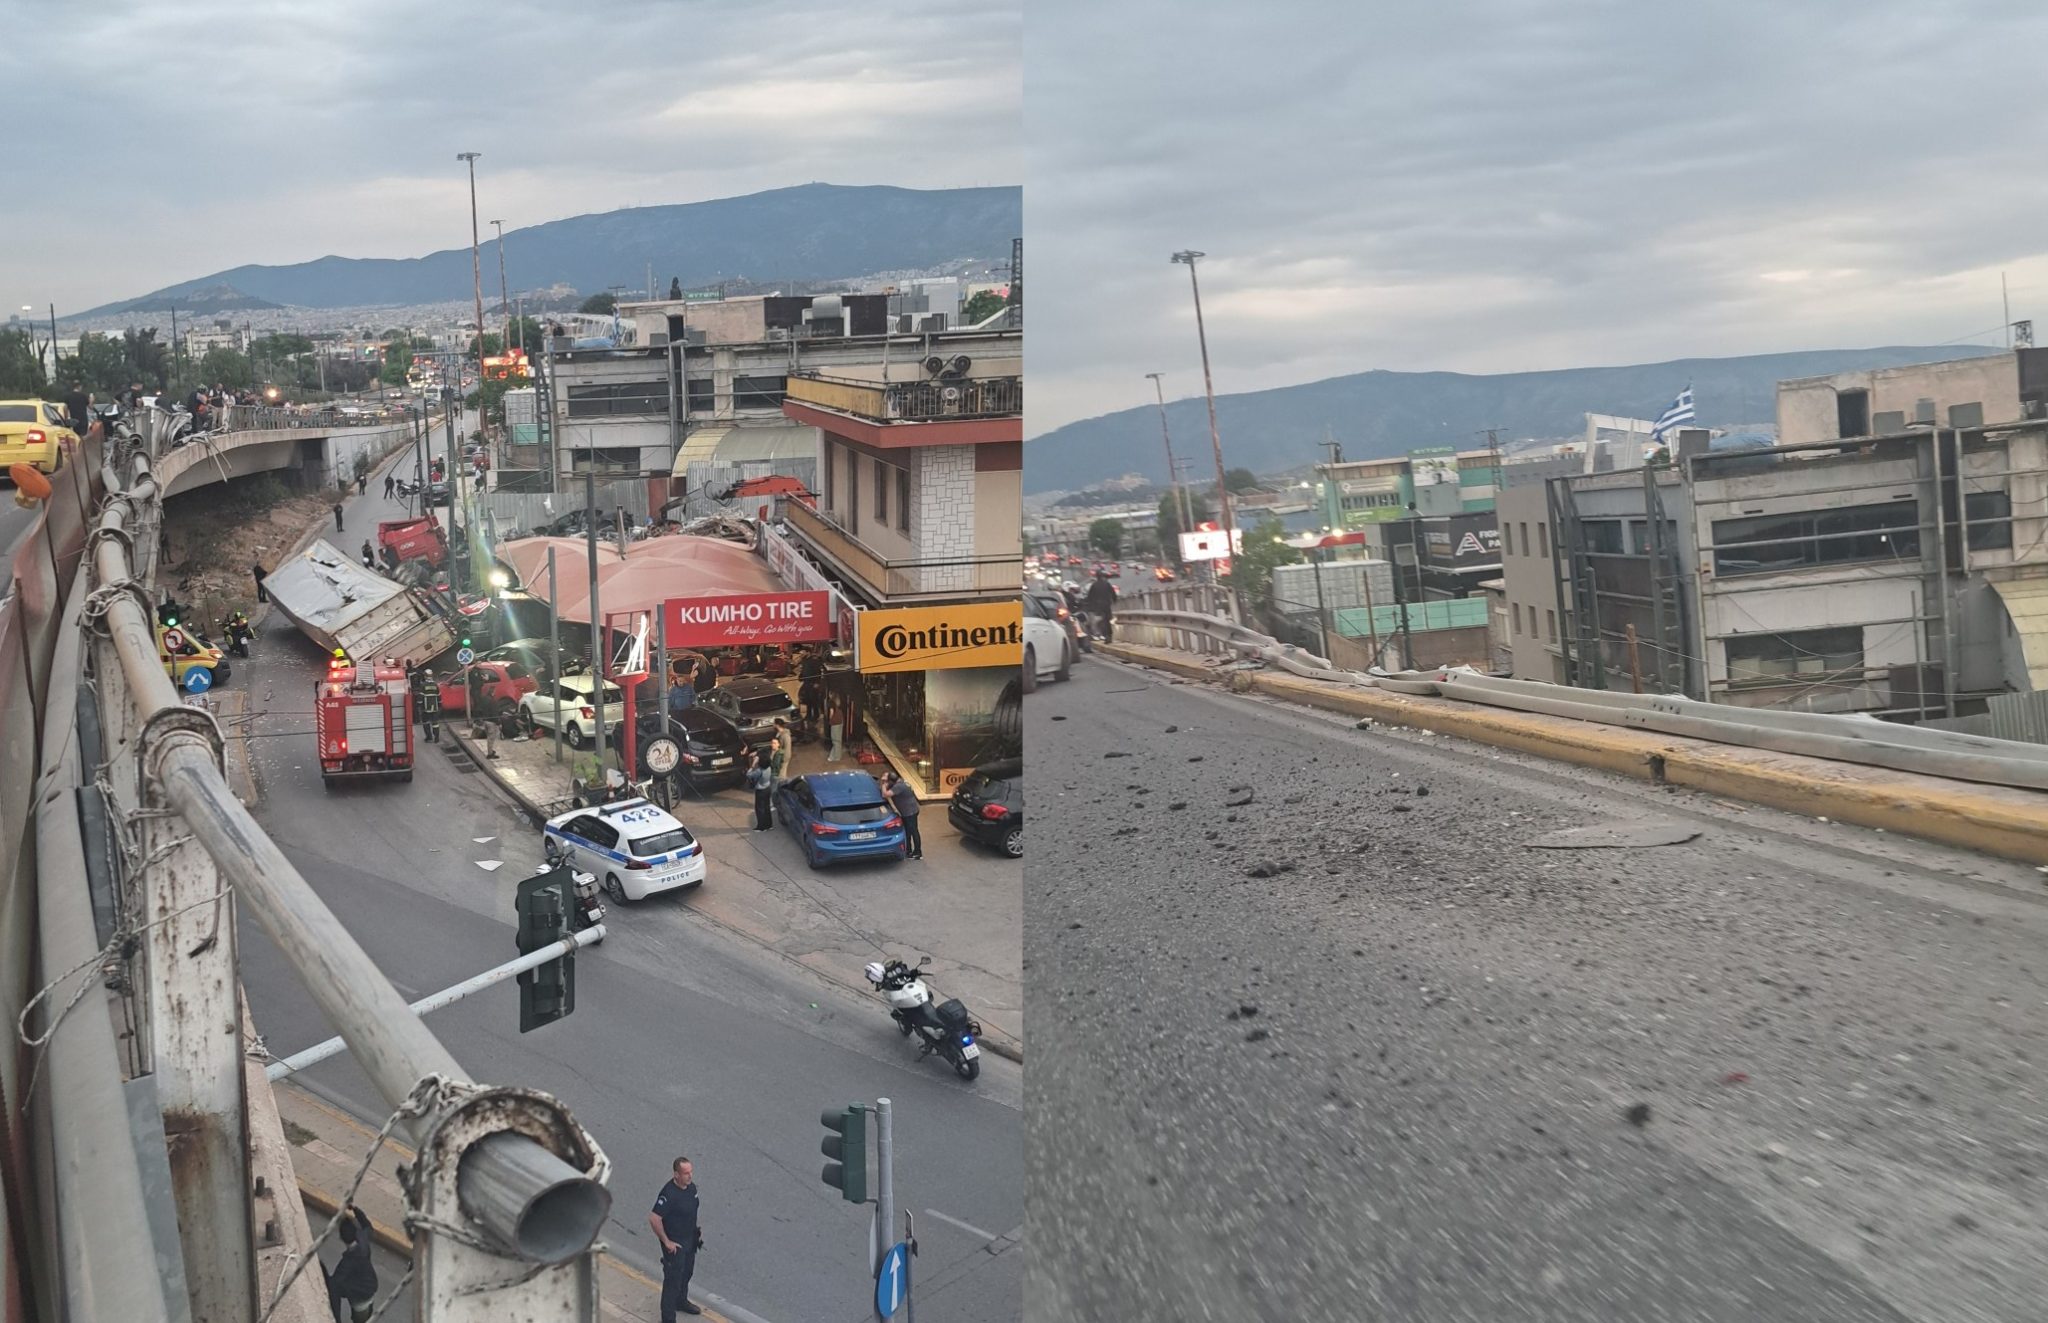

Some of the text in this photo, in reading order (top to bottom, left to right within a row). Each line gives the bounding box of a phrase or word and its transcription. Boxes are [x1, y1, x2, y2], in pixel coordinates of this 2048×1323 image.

[681, 601, 813, 624] KUMHO TIRE
[875, 622, 1023, 659] Continent
[661, 871, 690, 883] POLICE
